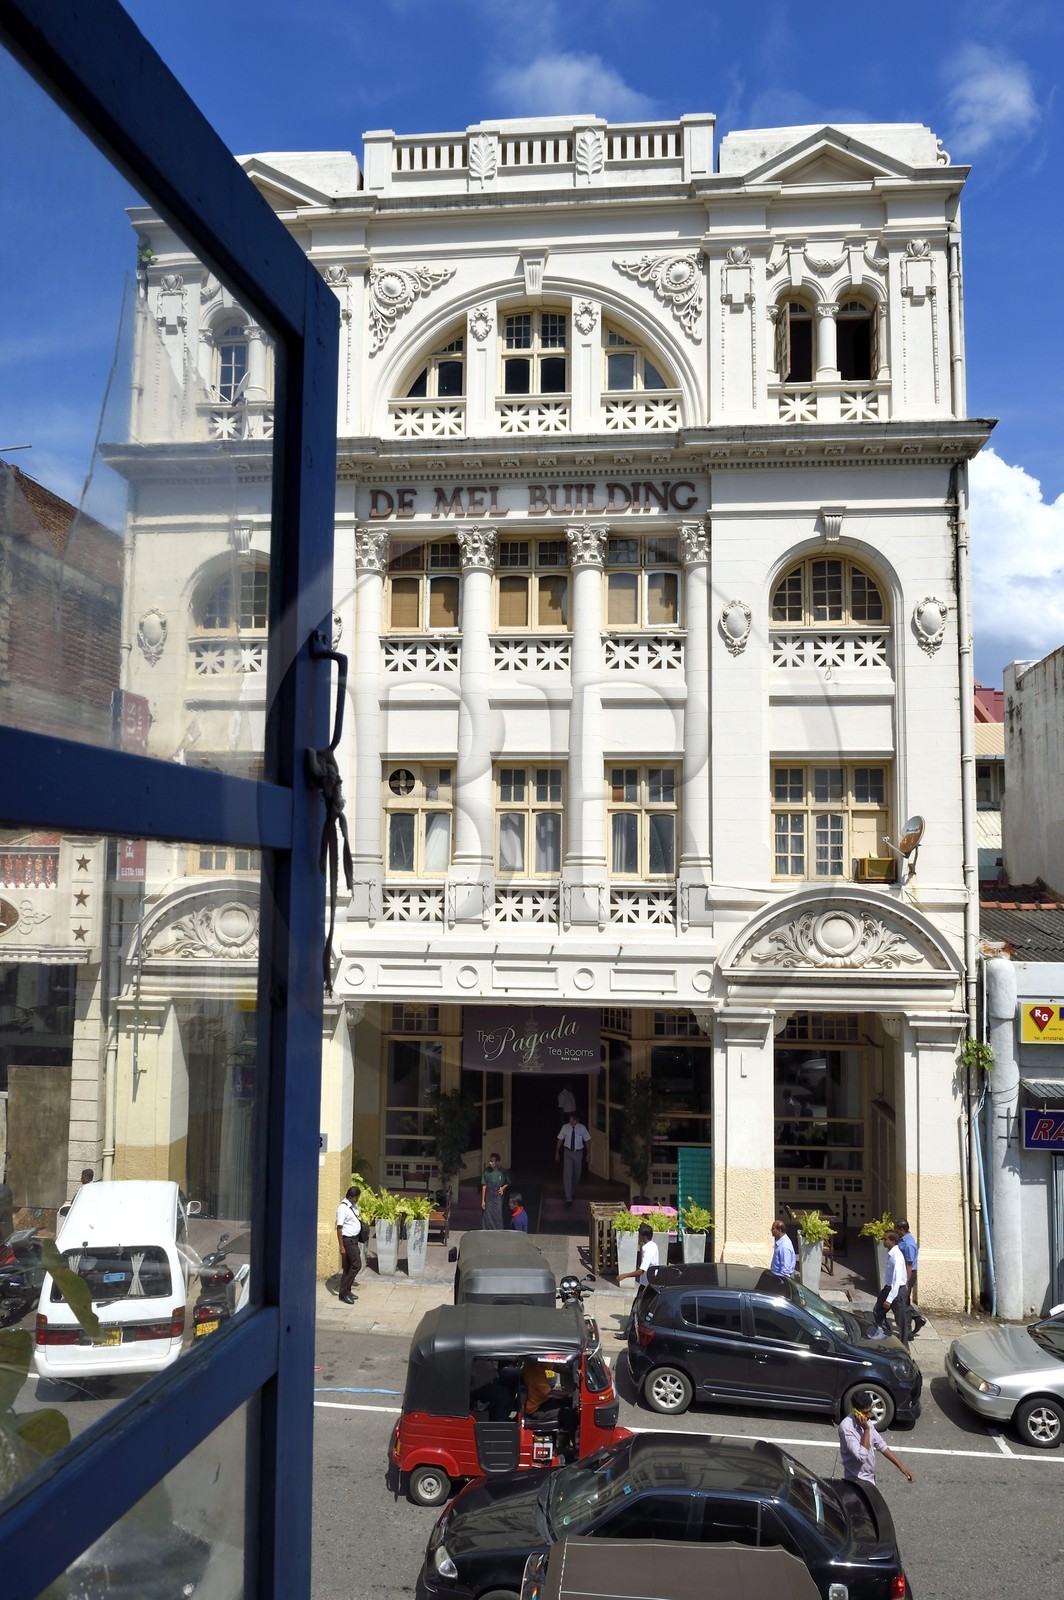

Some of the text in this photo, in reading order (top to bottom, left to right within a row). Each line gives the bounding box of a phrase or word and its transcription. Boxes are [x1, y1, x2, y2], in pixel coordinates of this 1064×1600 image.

[369, 480, 698, 518] DE MEL BUILDING
[476, 1014, 579, 1063] The Pagoda
[547, 1046, 594, 1057] Tea Rooms
